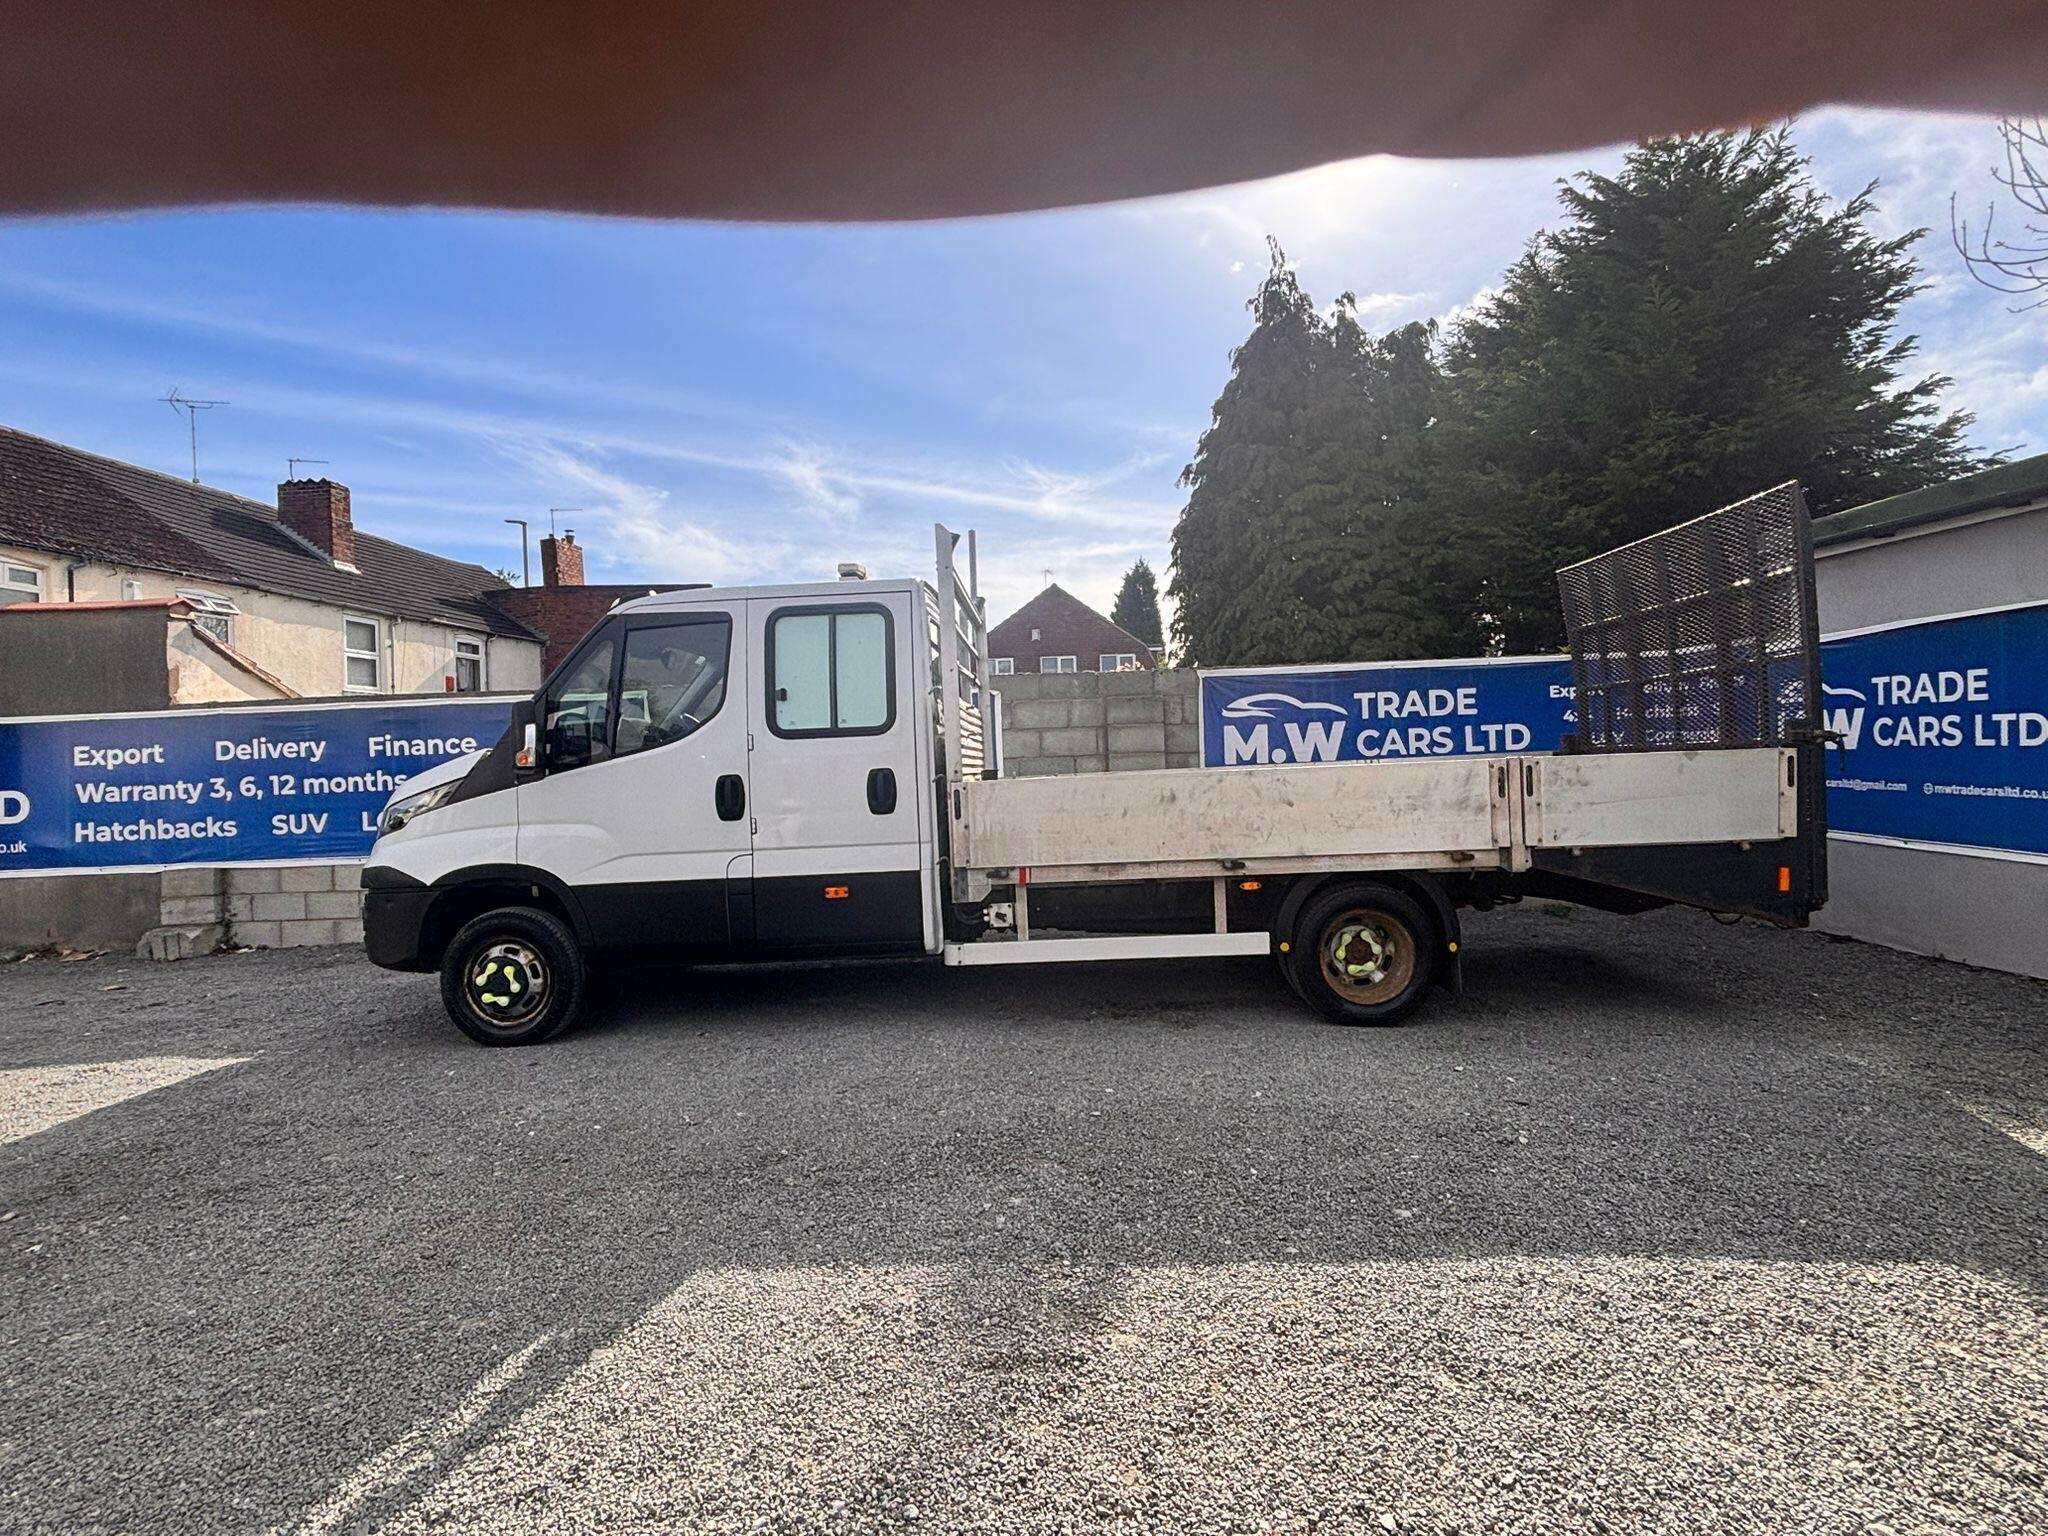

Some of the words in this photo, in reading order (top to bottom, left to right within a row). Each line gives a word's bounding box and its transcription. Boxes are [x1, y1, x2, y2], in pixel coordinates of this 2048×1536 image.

[1354, 687, 1478, 719] TRADE
[1872, 668, 1989, 706] TRADE
[1223, 721, 1347, 765] M.W
[1356, 726, 1454, 757] CARS
[1465, 723, 1531, 752] LTD
[1873, 715, 1963, 747] CARS
[1974, 713, 2048, 747] LTD
[74, 744, 165, 770] Export
[215, 737, 327, 762] Delivery
[369, 735, 477, 757] Finance
[75, 781, 203, 805] Warranty
[209, 777, 233, 802] 3,
[239, 775, 264, 801] 6,
[269, 774, 296, 796] 12
[75, 816, 238, 843] Hatchbacks
[271, 812, 328, 835] SUV
